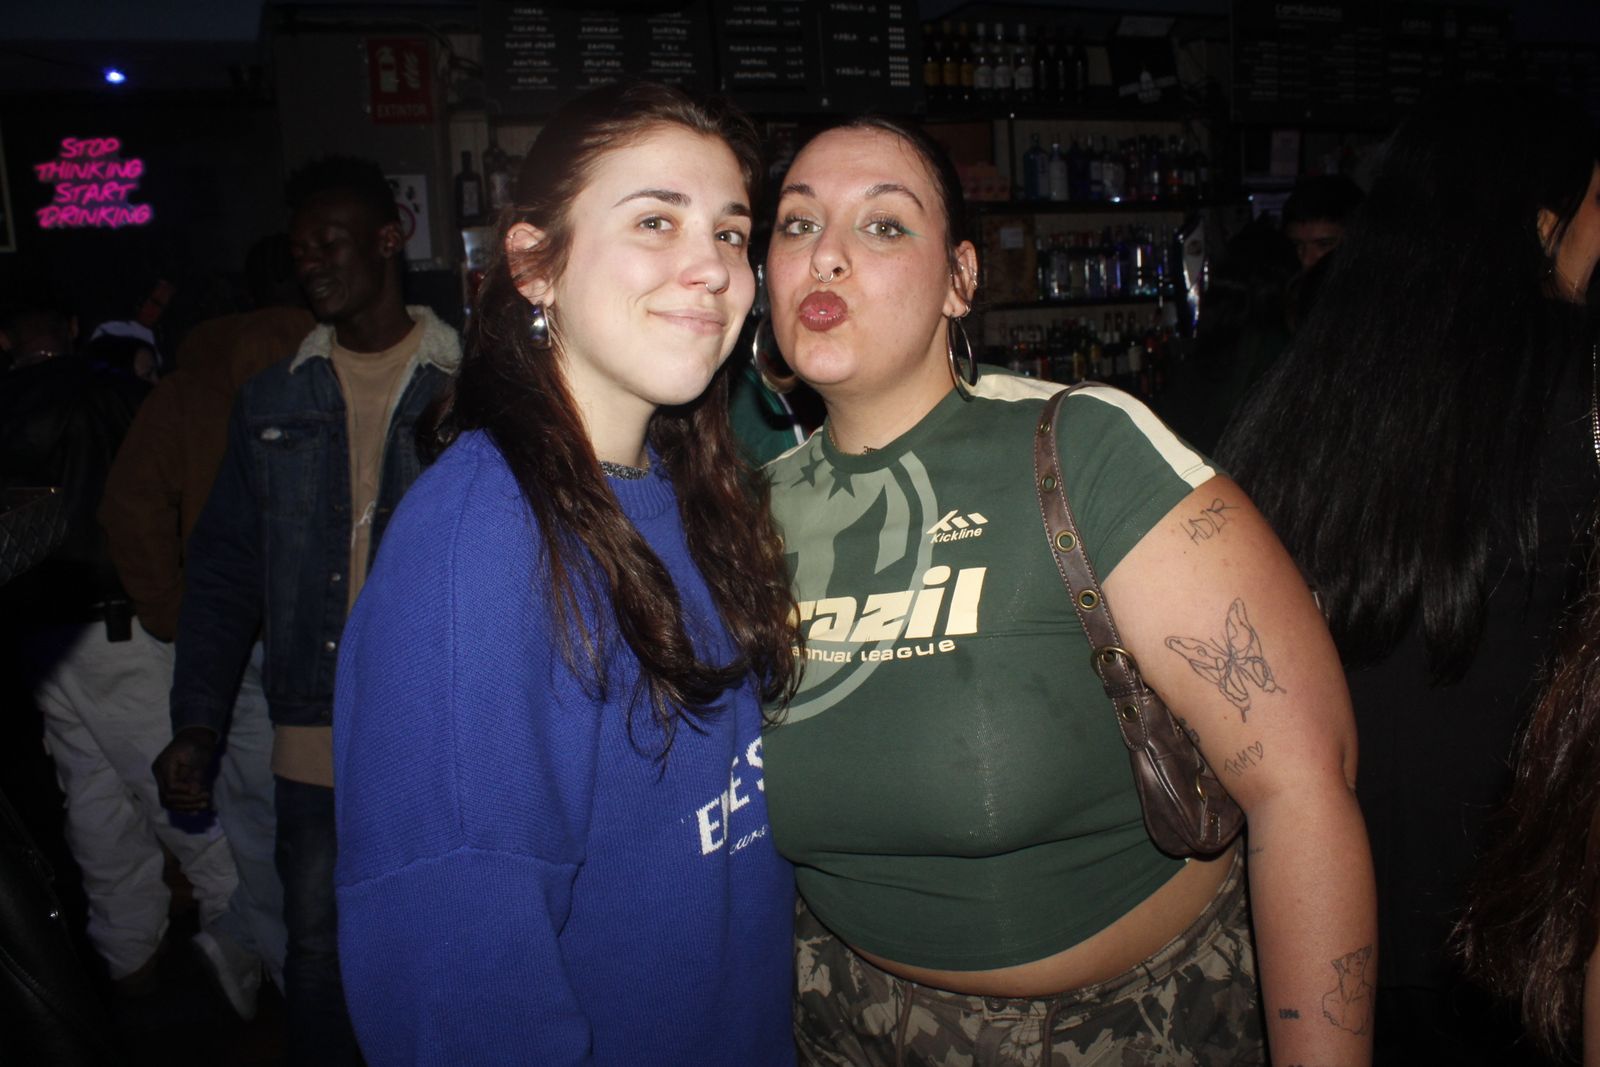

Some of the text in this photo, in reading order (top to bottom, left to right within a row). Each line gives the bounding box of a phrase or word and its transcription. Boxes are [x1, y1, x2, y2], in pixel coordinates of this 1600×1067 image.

[60, 137, 121, 158] STOP
[34, 158, 144, 181] THINKING
[54, 181, 138, 204] START
[36, 203, 153, 228] DRINKING
[930, 527, 983, 544] Kickline
[785, 565, 987, 643] razil
